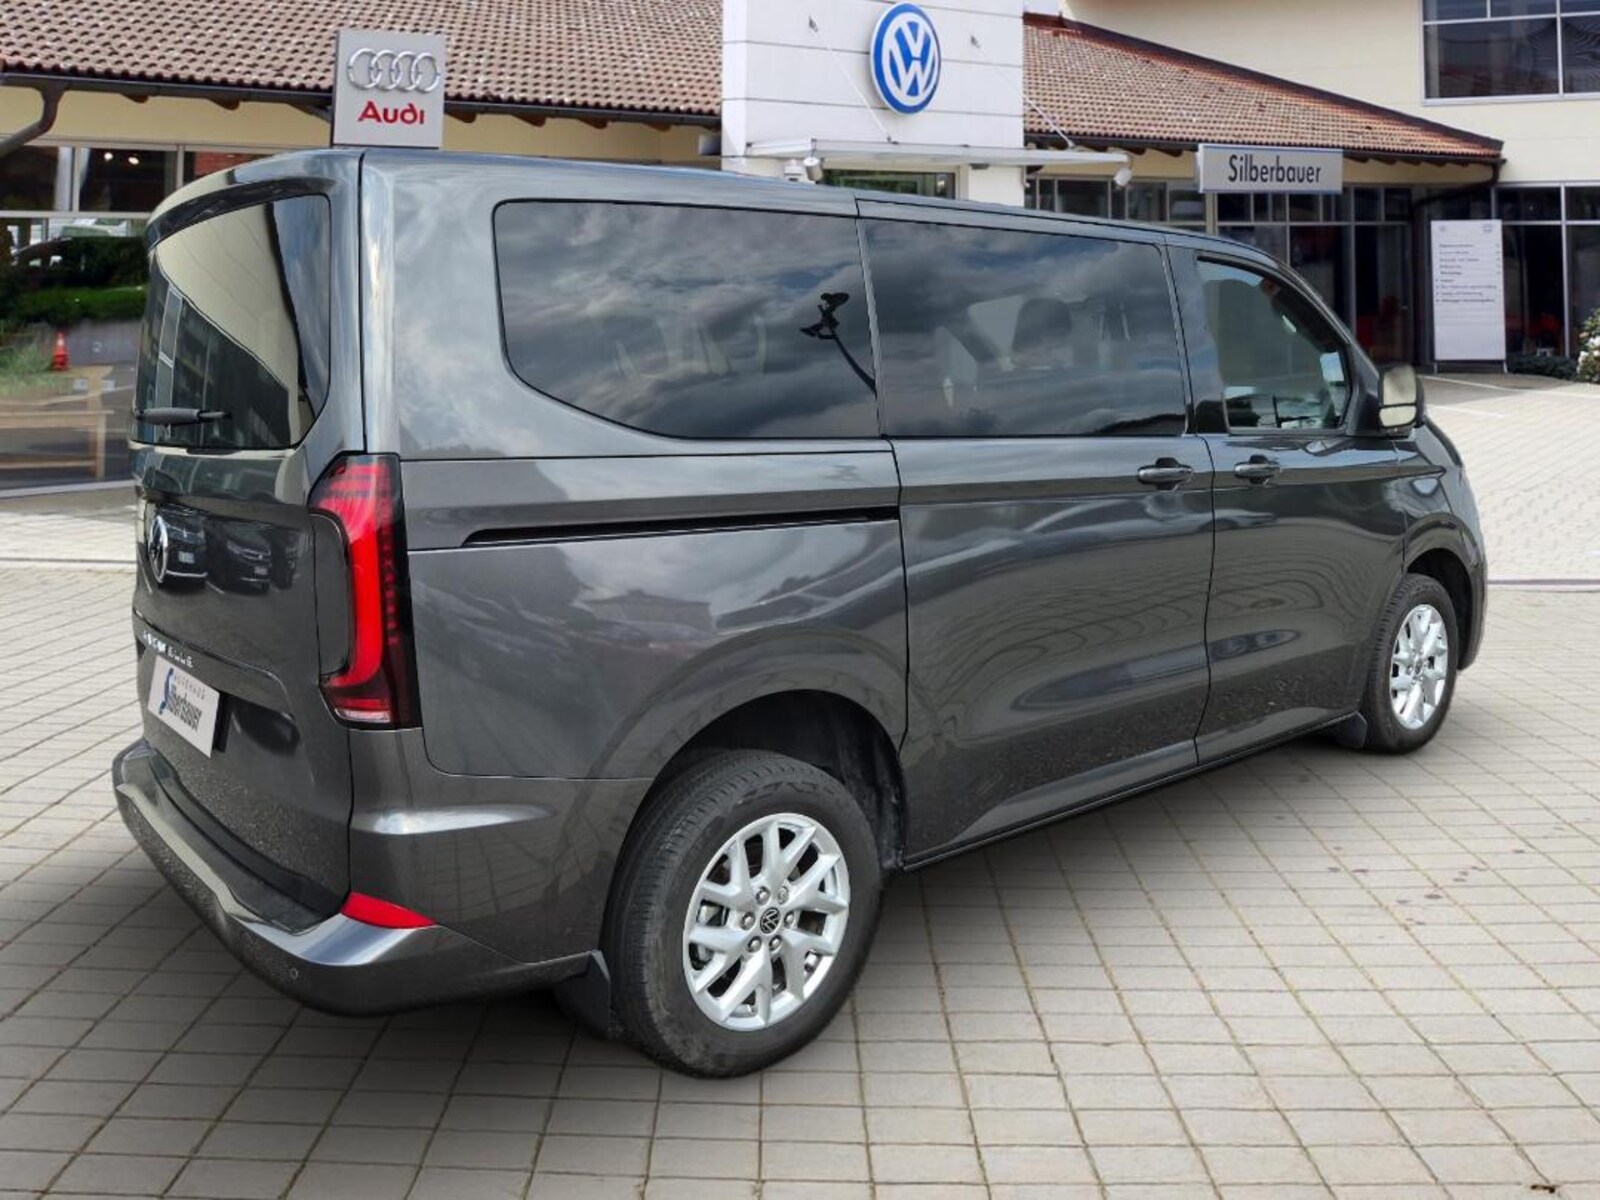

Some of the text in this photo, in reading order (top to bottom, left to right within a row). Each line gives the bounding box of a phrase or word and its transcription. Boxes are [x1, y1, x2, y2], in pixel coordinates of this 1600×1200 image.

[879, 8, 937, 108] VW
[358, 101, 424, 125] Audi
[1228, 154, 1321, 183] Silberbauer
